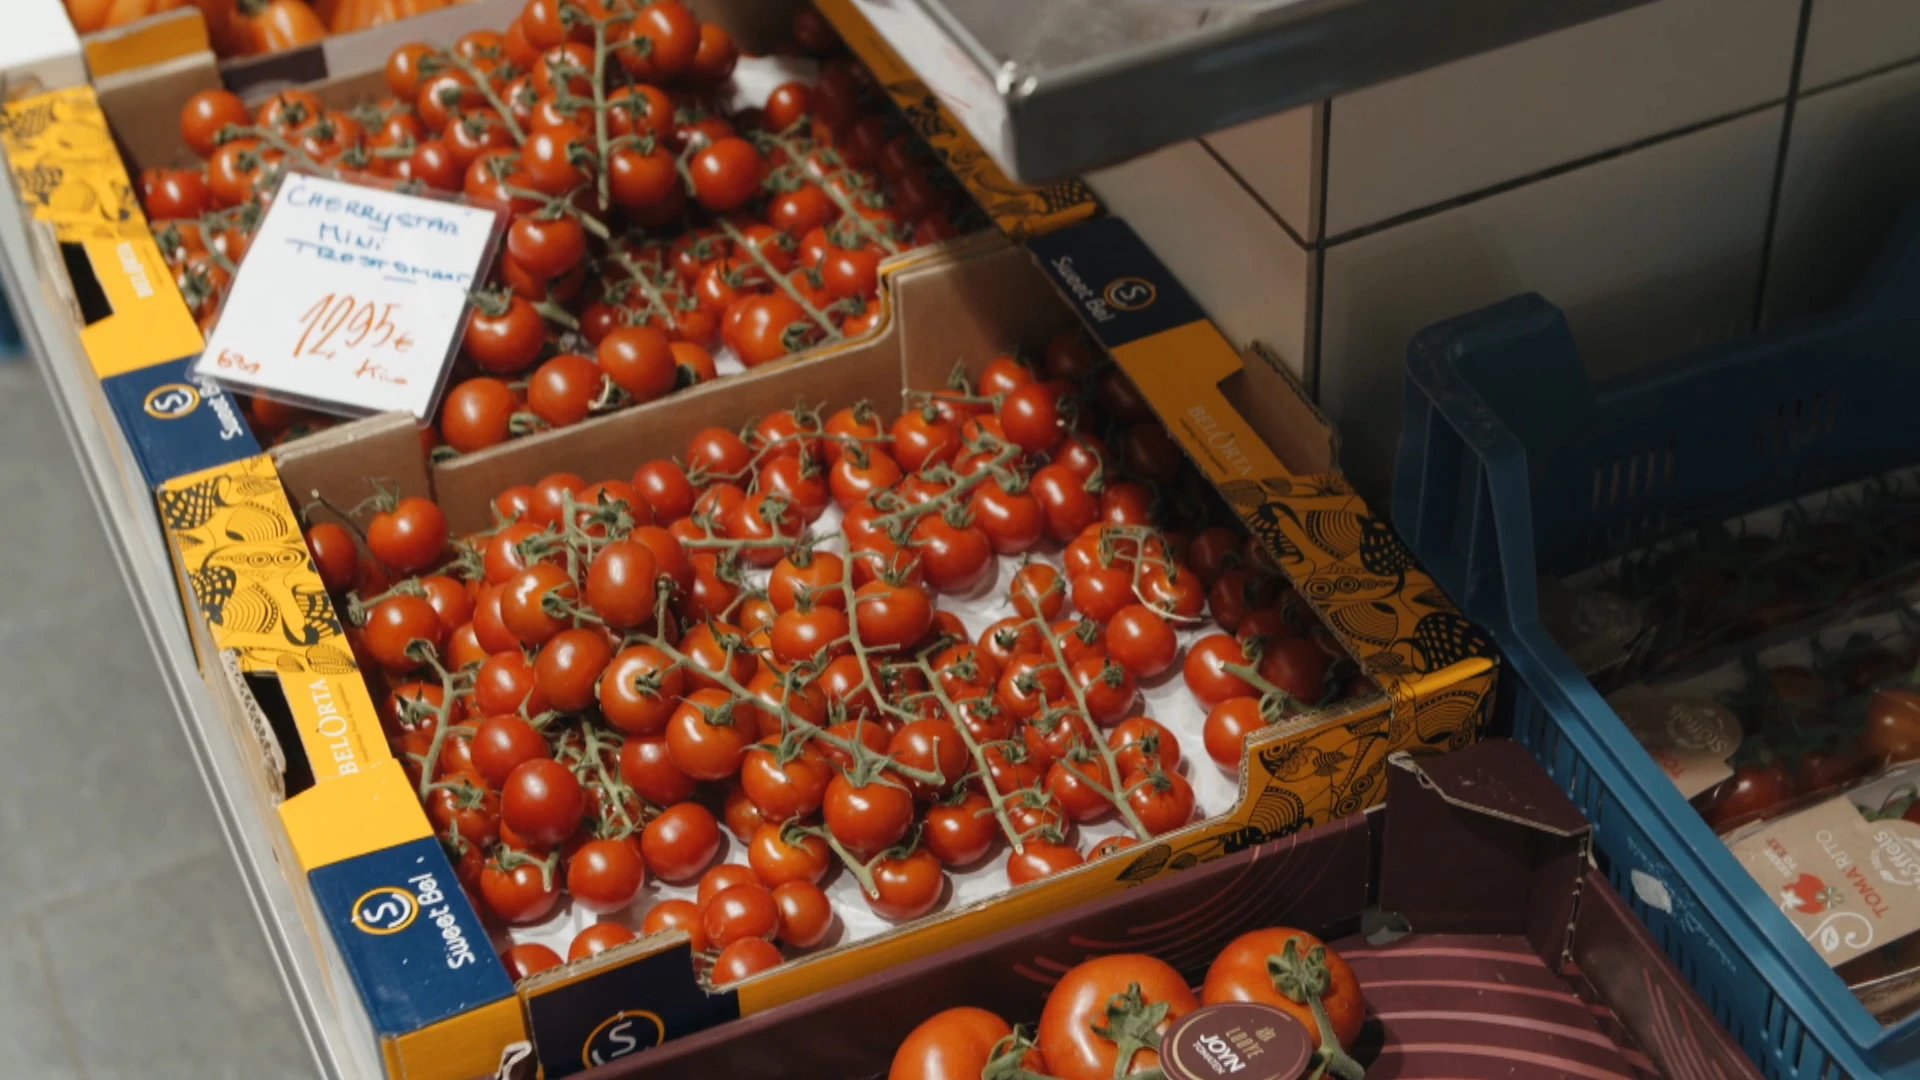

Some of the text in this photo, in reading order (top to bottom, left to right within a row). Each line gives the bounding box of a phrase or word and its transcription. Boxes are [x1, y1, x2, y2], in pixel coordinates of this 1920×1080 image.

[308, 677, 360, 777] BELORTA
[407, 871, 476, 970] Sweet Bel
[1199, 1033, 1247, 1074] JOYN
